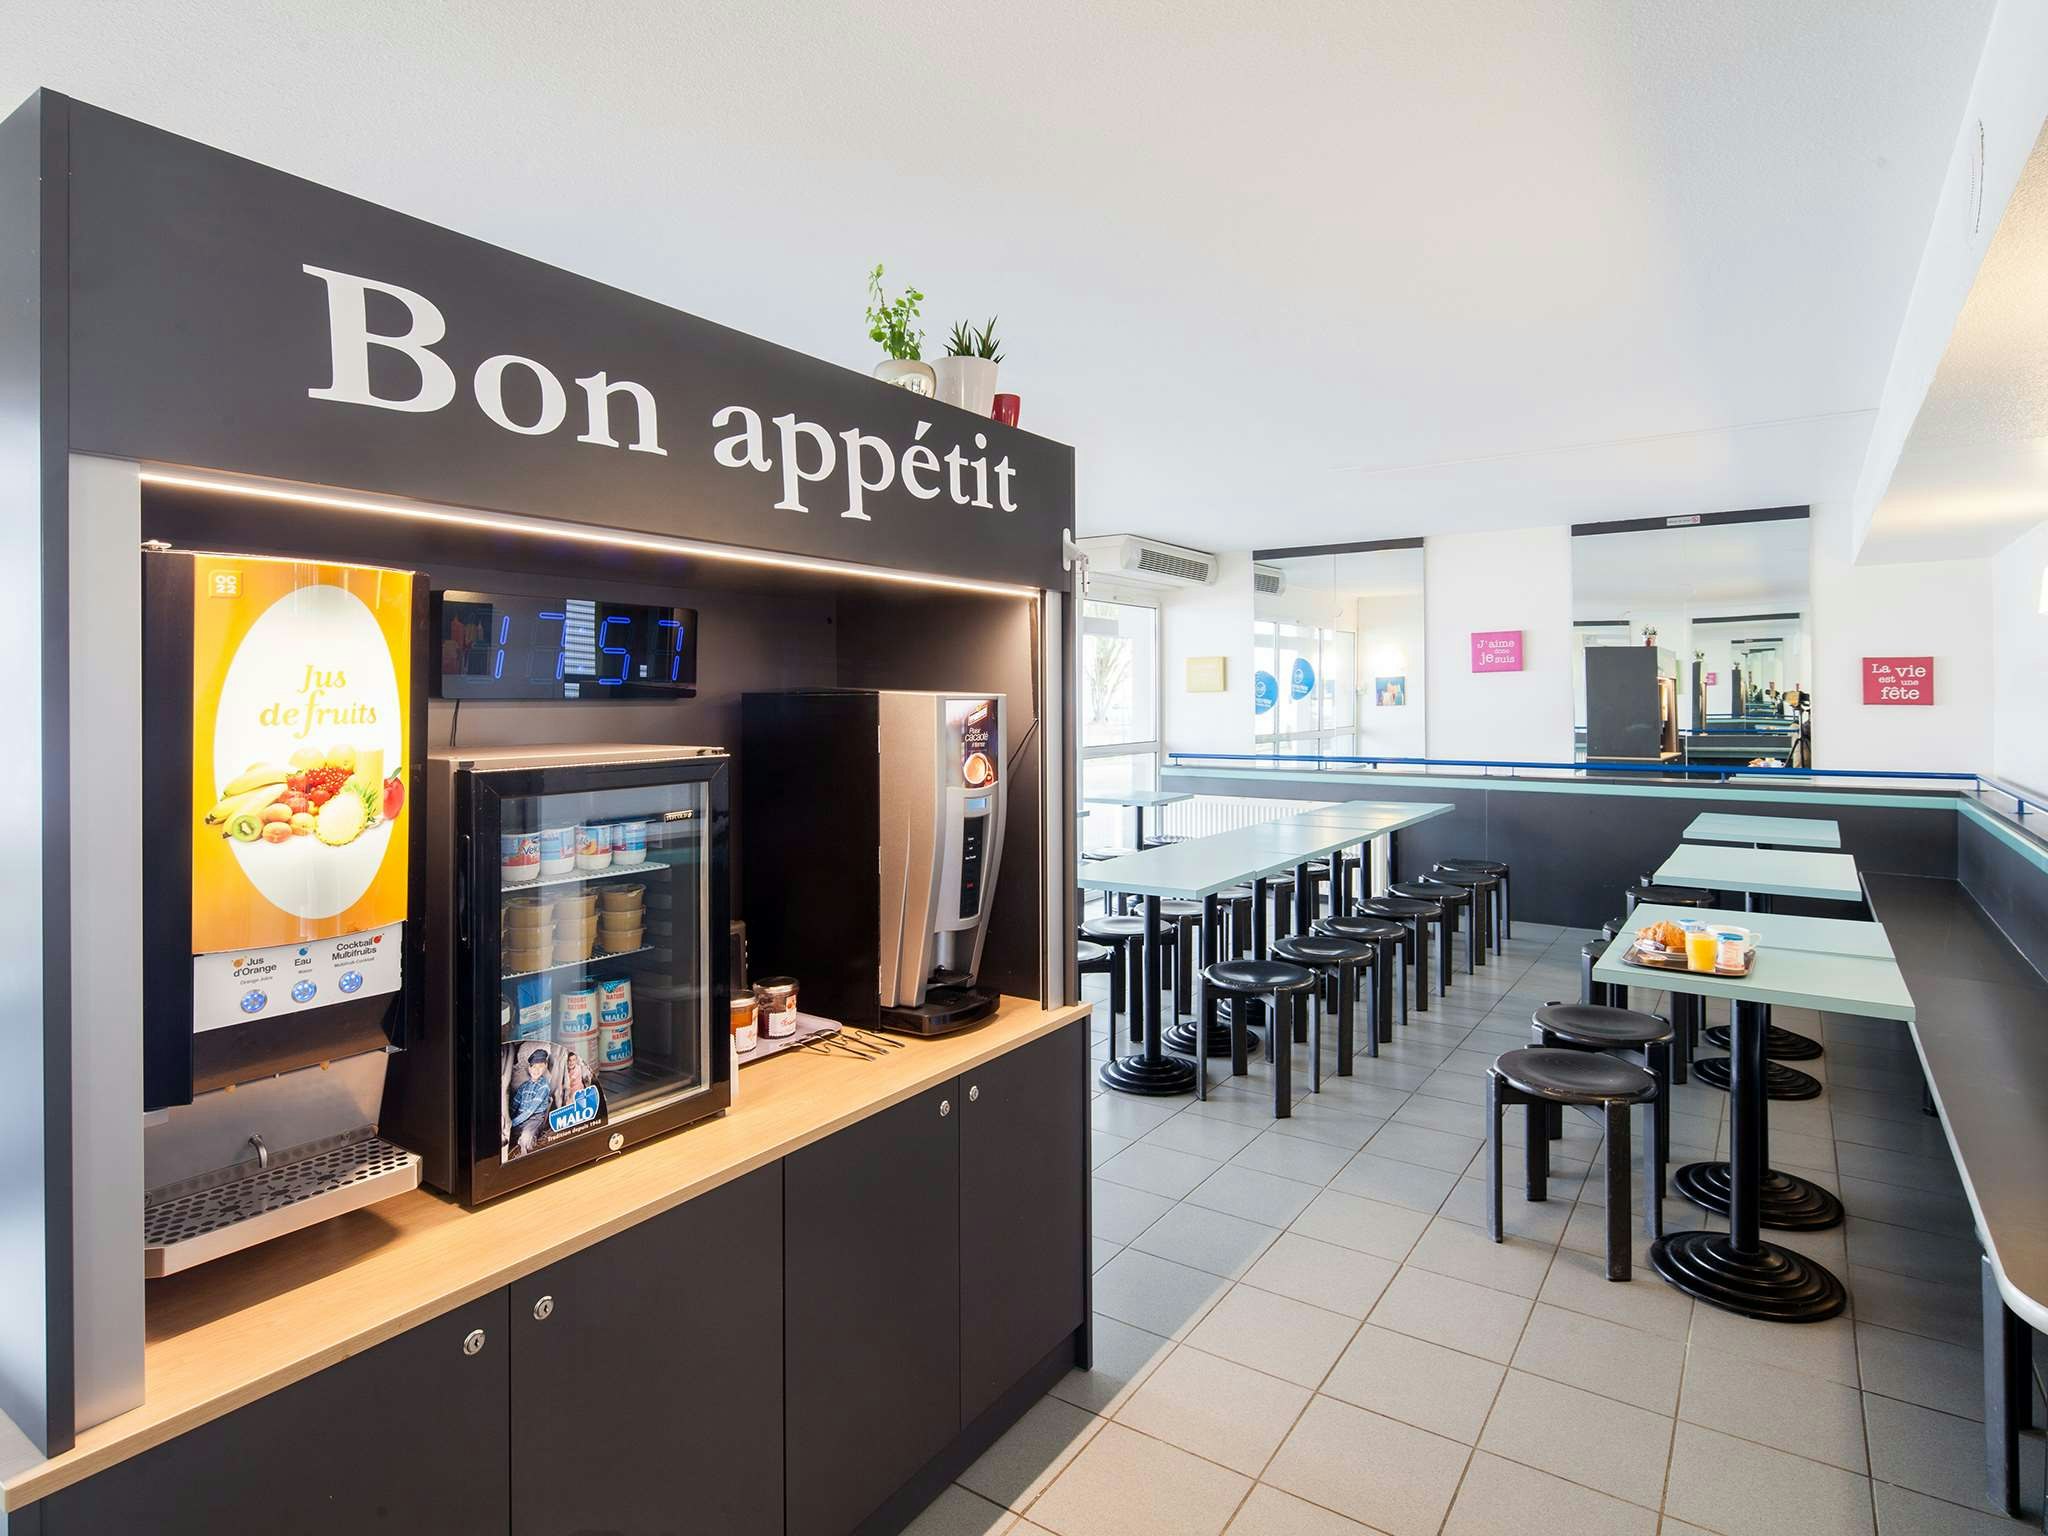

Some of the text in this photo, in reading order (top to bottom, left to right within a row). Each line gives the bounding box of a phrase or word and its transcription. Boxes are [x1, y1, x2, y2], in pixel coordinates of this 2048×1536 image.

[303, 264, 1018, 521] Bon appétit
[1477, 640, 1515, 648] J'aime
[1480, 652, 1515, 665] je suis
[1872, 663, 1926, 677] La vie
[297, 664, 347, 693] Jus
[1878, 675, 1896, 683] est
[1881, 686, 1920, 700] fête
[259, 690, 377, 739] de fruits
[336, 937, 373, 952] Cocktail
[331, 946, 377, 960] Multifruits
[247, 956, 264, 967] Jus
[294, 957, 312, 967] Eau
[233, 963, 277, 978] d'Orange
[604, 1013, 627, 1022] MALO
[556, 1107, 594, 1130] MALO
[547, 1130, 572, 1142] Tradition
[572, 1124, 589, 1135] depuis
